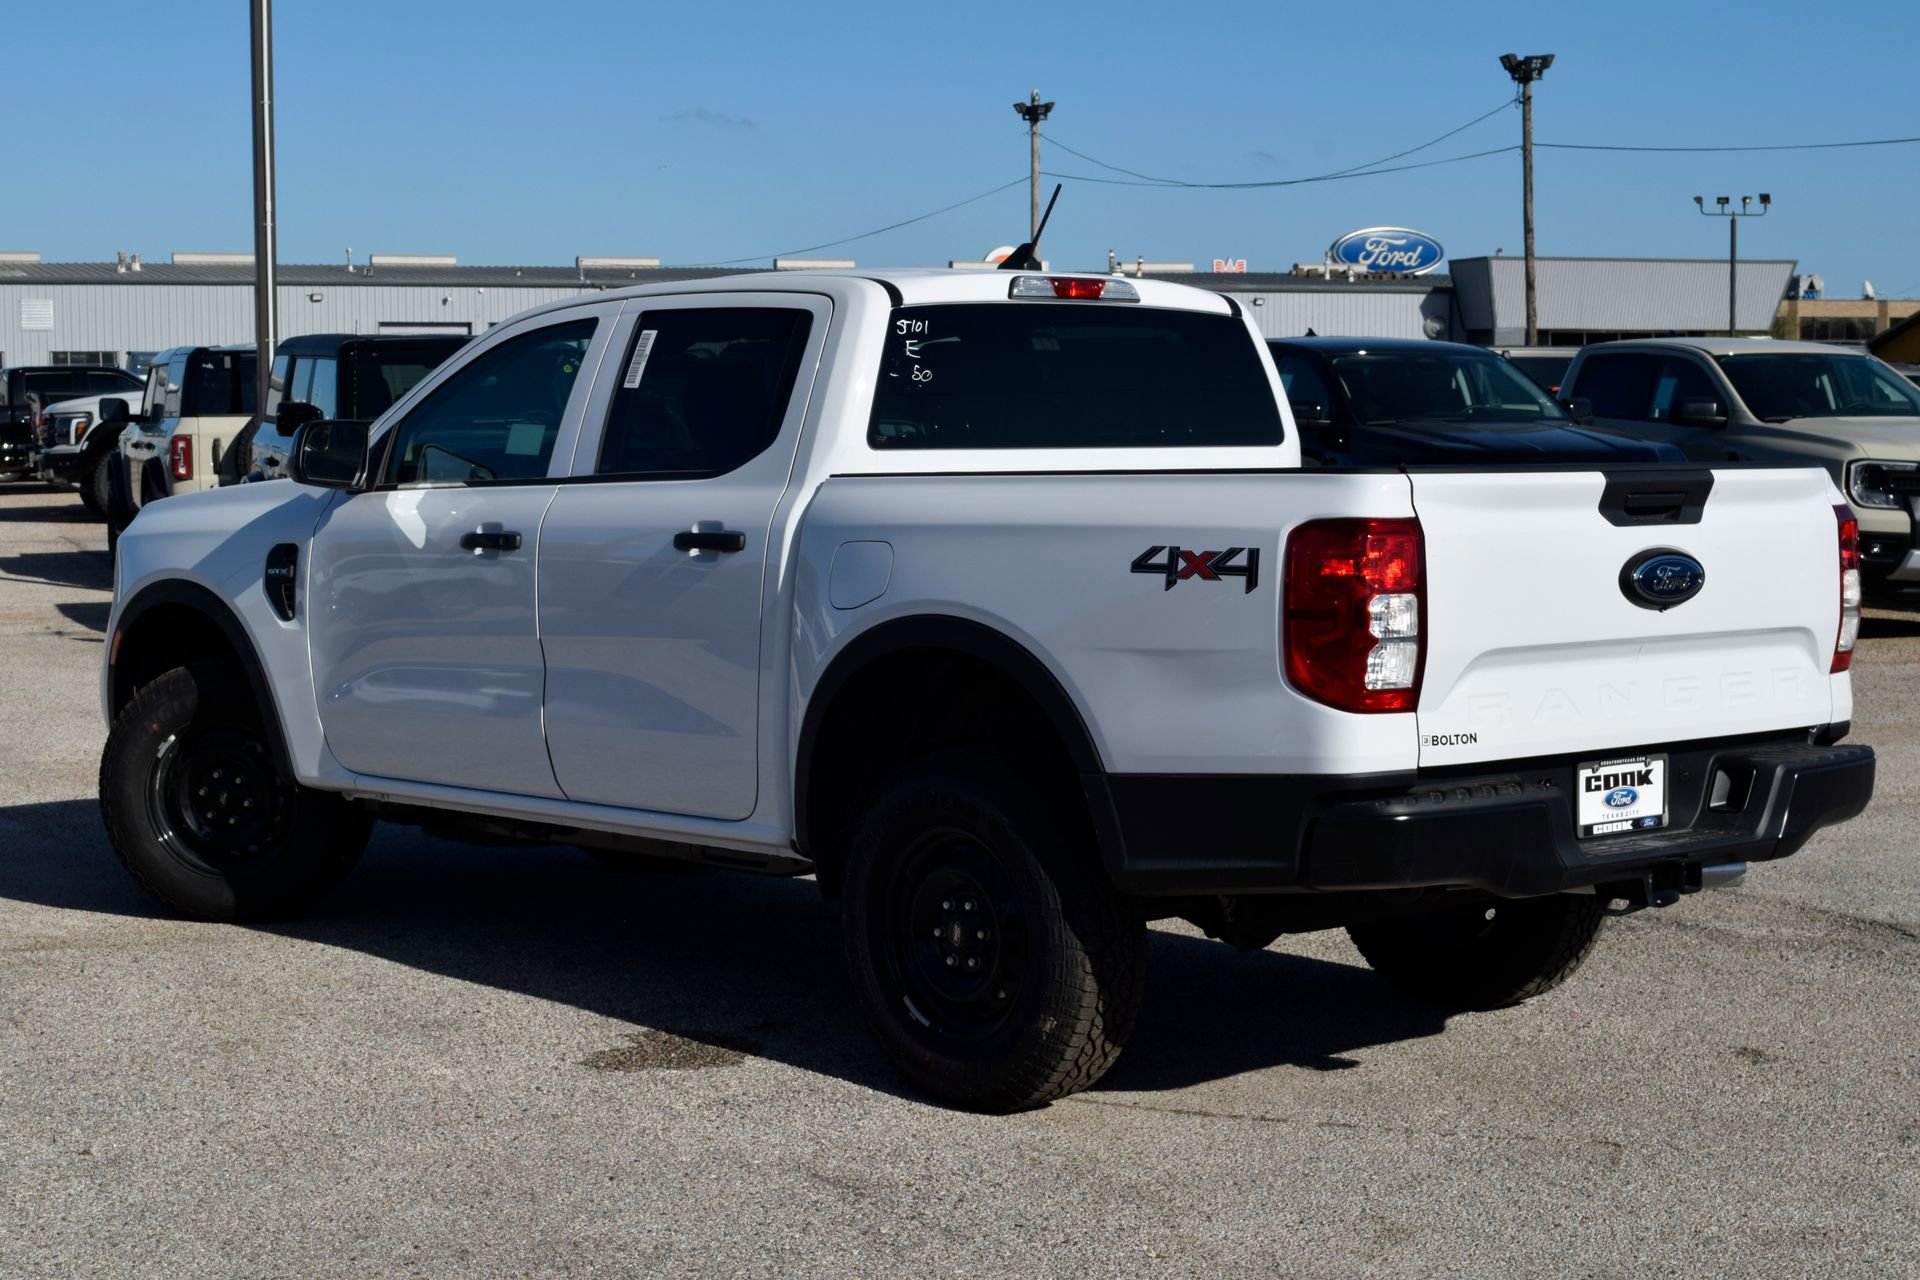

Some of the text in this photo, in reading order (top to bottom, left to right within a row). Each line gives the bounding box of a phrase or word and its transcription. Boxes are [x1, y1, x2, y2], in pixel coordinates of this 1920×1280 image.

[1359, 237, 1423, 267] Ford
[1467, 666, 1809, 725] RANGER
[1431, 732, 1478, 747] BOLTON
[1585, 768, 1654, 793] COOK
[1611, 790, 1633, 806] Ford
[1592, 820, 1634, 835] COOK
